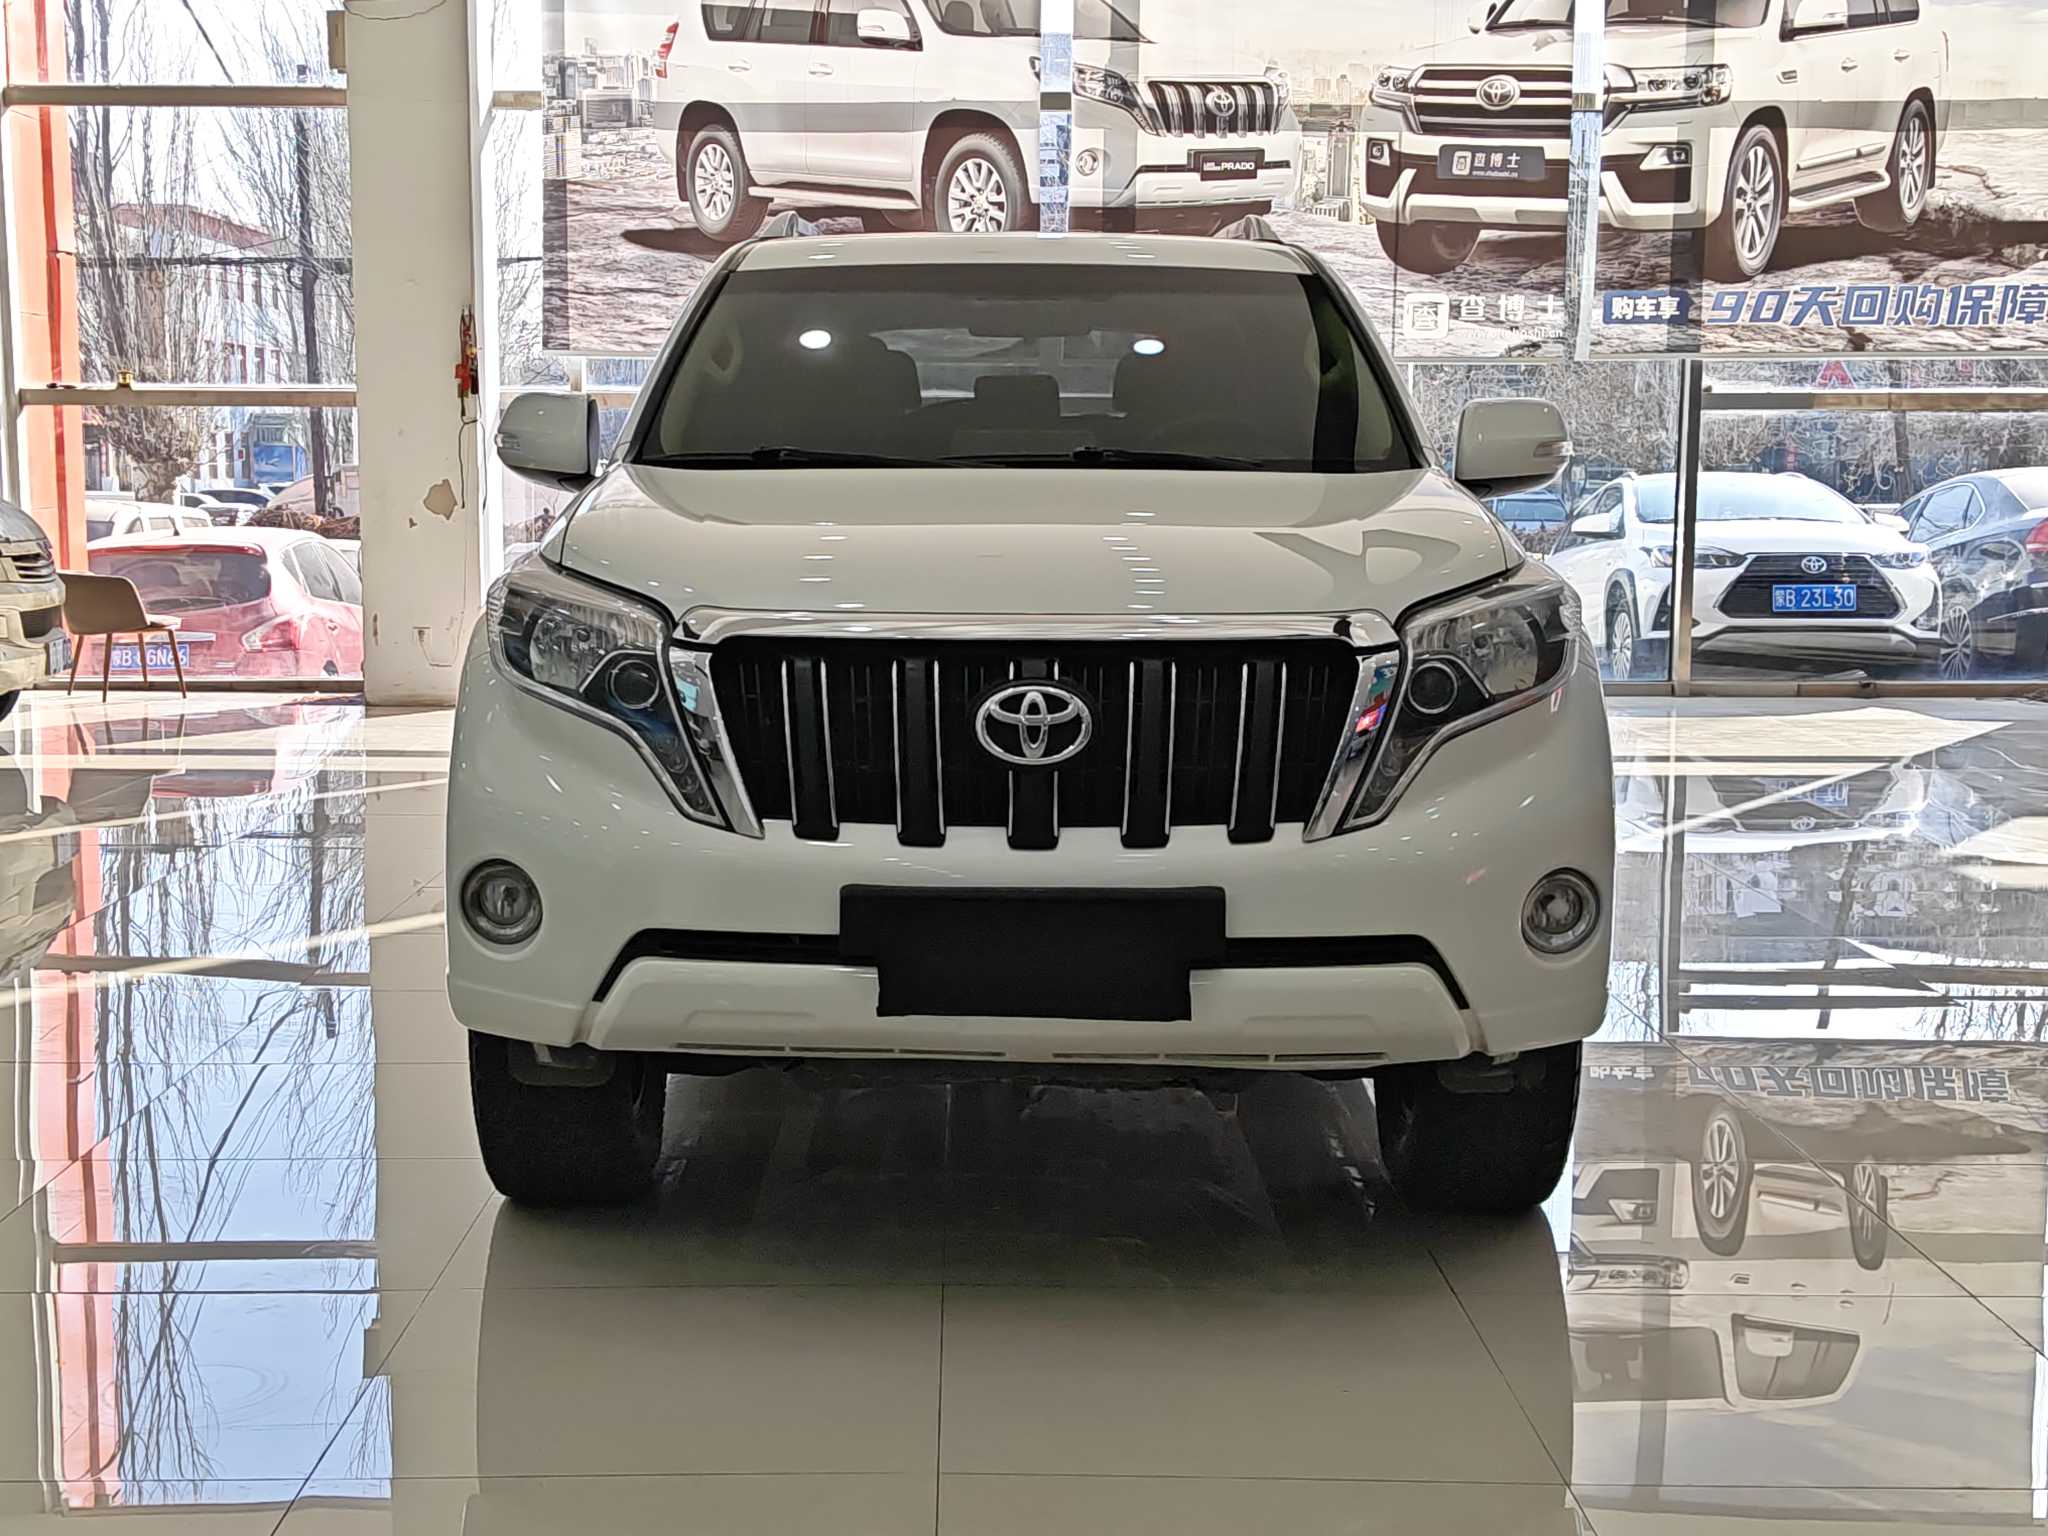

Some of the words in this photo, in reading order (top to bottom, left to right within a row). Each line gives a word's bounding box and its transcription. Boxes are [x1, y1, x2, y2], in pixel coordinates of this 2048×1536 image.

[1221, 161, 1255, 171] PRADO
[1457, 294, 1565, 322] 查博士
[1610, 295, 1681, 320] 购车享
